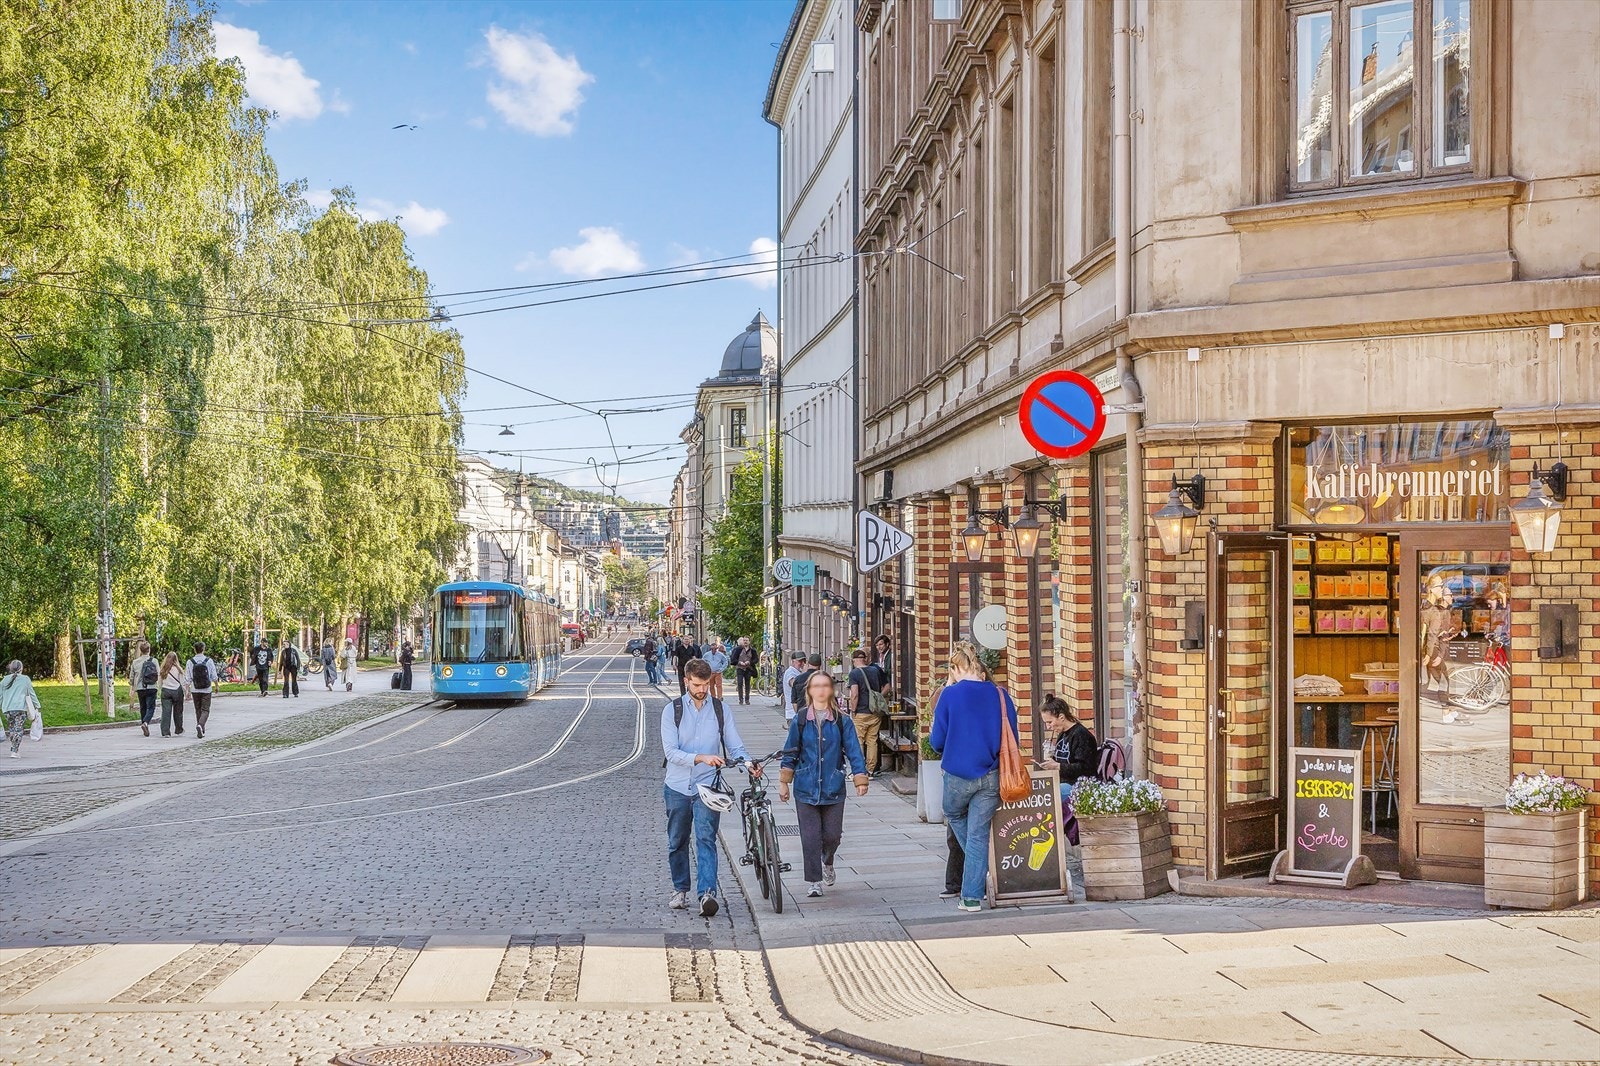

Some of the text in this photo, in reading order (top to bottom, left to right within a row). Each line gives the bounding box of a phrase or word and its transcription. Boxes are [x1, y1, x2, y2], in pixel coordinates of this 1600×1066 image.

[1306, 460, 1504, 499] Kaffebrenneriet
[866, 518, 902, 566] BAR
[466, 668, 481, 676] 421
[1326, 760, 1336, 771] vi
[1338, 759, 1354, 774] har
[1295, 779, 1354, 800] ISKREM
[1318, 803, 1330, 818] &
